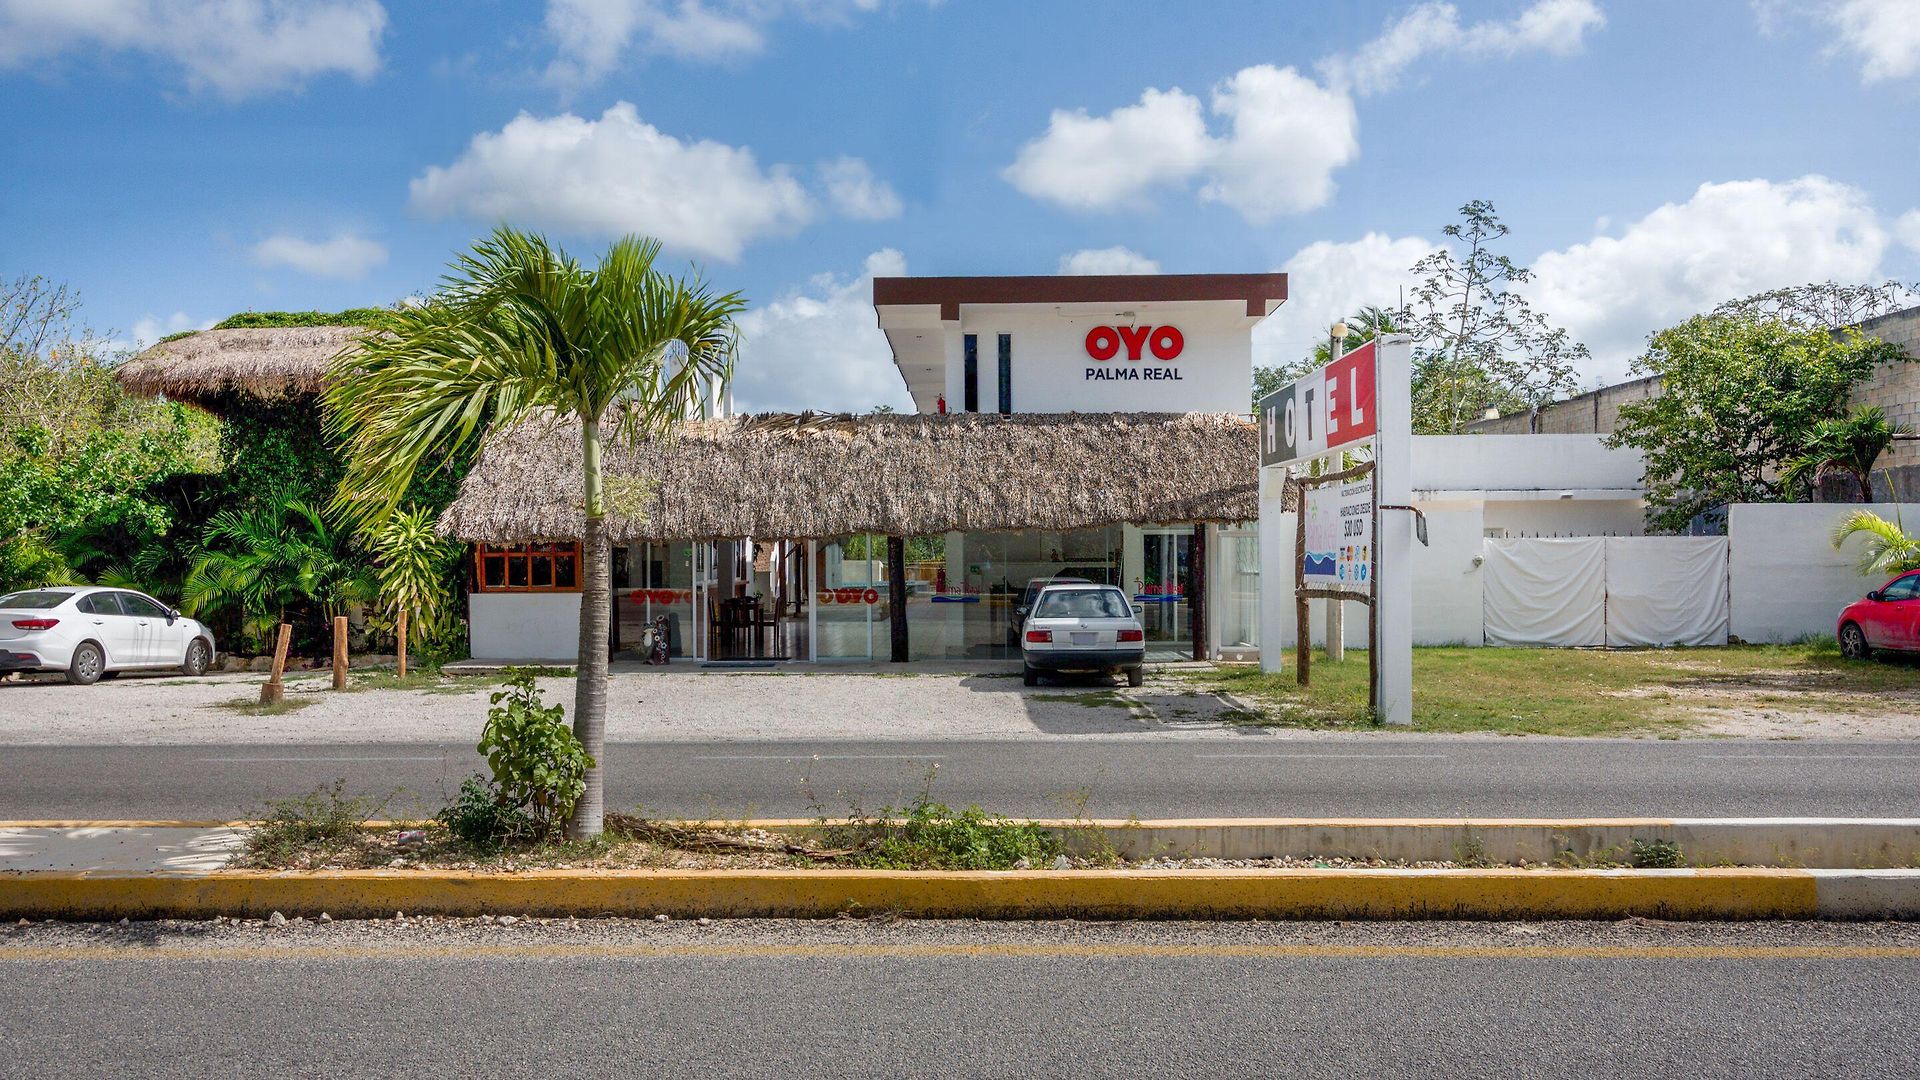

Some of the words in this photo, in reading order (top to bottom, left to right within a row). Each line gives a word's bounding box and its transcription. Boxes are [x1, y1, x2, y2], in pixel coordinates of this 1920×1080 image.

[1085, 325, 1185, 361] OYO
[1085, 368, 1139, 380] PALMA
[1143, 368, 1183, 380] REAL
[1266, 366, 1364, 455] HOTEL
[1353, 518, 1363, 537] USD
